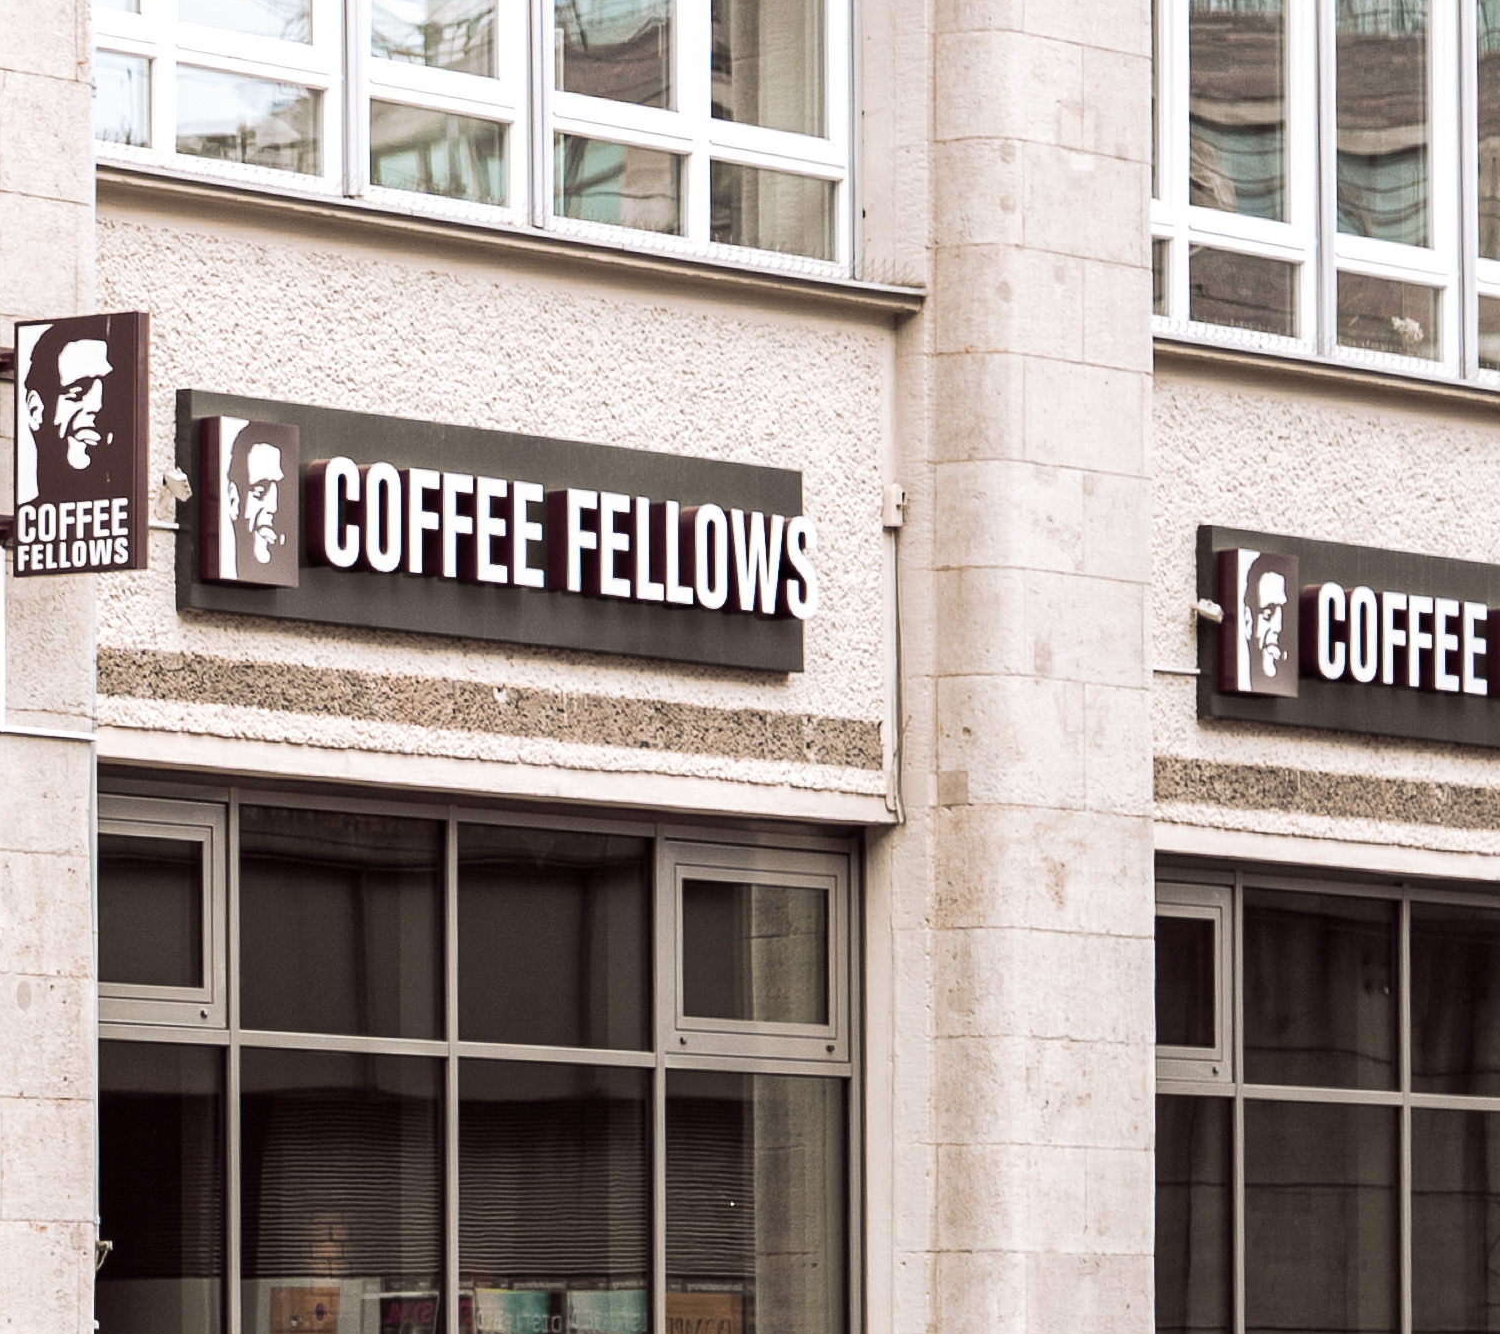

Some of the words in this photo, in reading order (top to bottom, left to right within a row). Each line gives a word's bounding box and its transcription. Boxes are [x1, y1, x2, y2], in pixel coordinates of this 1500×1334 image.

[17, 498, 130, 543] COFFEE
[17, 536, 130, 572] FELLOWS
[323, 455, 546, 589] COFFEE
[568, 488, 820, 621] FELLOWS
[1317, 581, 1489, 696] COFFEE
